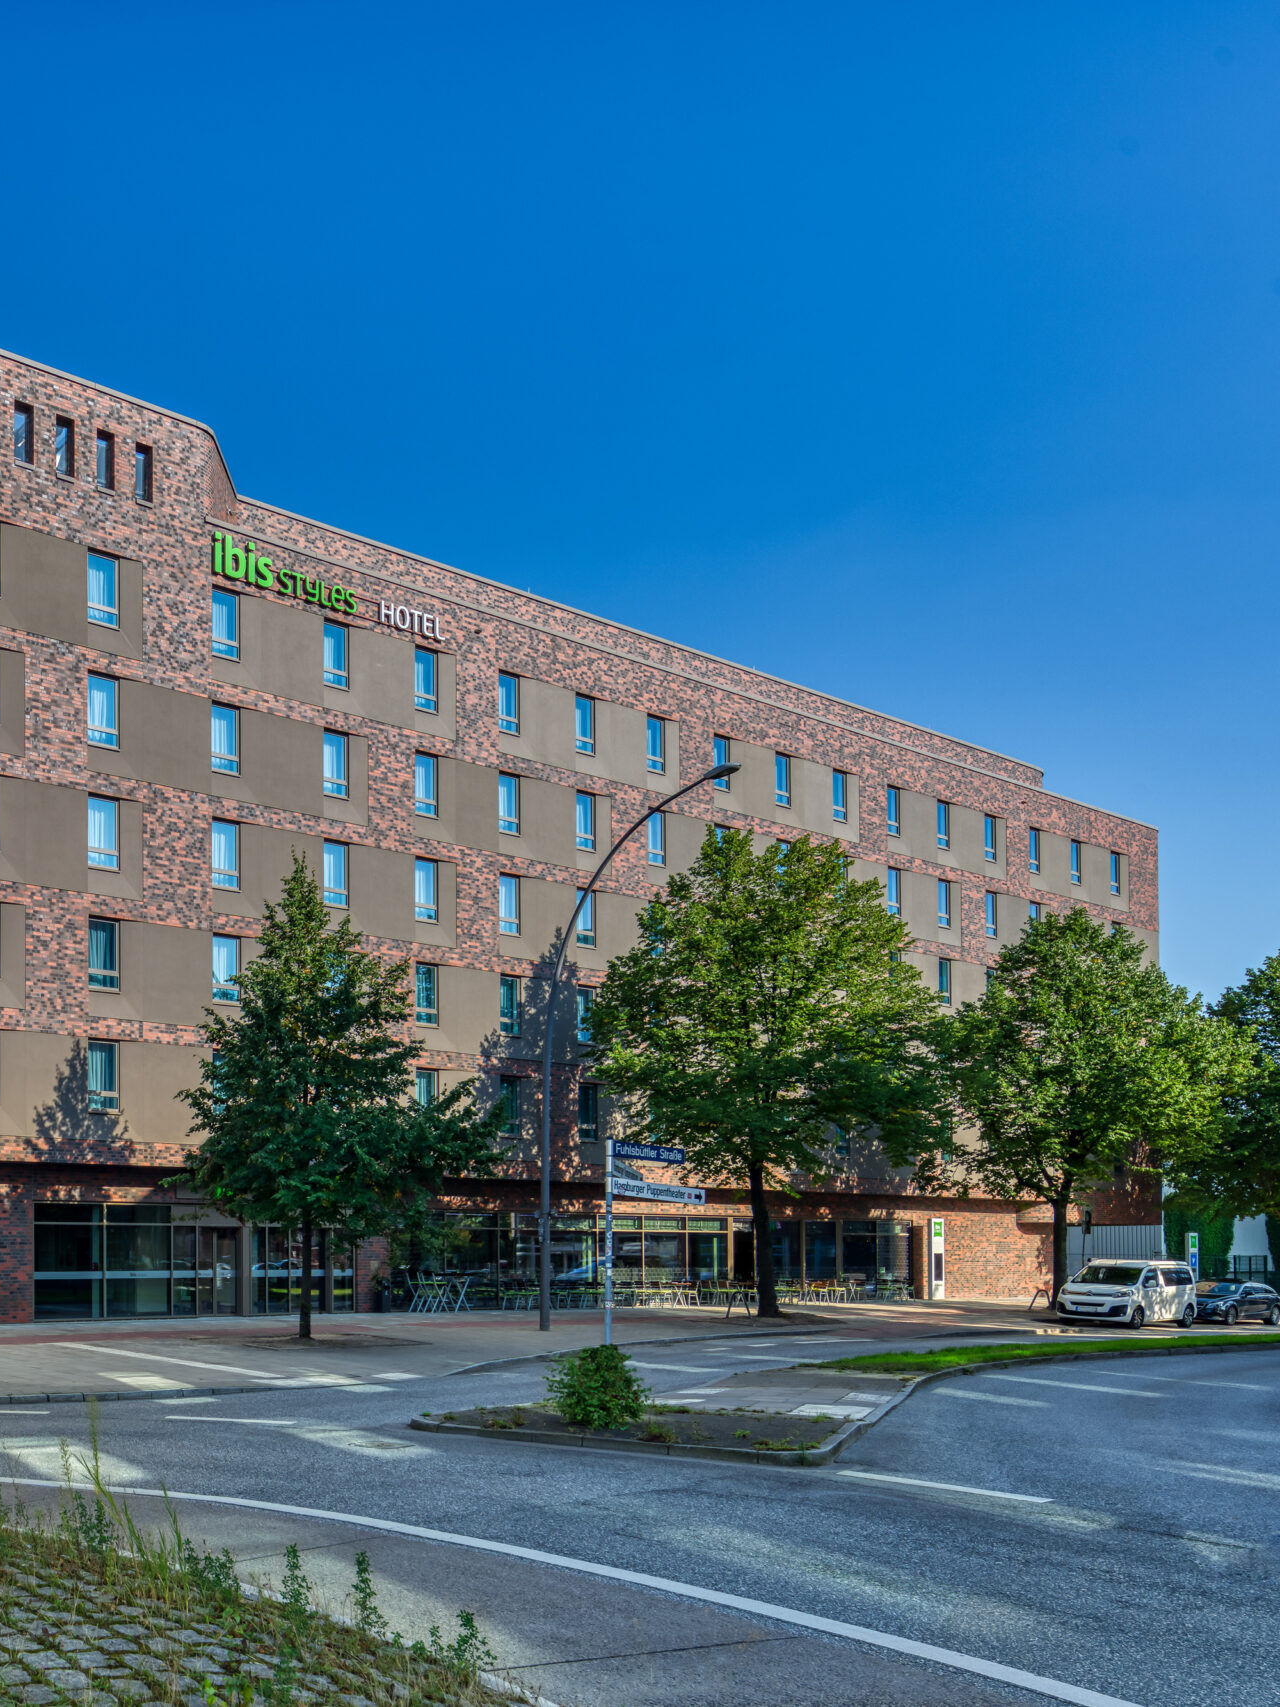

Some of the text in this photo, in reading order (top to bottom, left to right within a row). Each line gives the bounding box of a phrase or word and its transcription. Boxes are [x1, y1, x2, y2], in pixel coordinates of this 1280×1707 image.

[213, 530, 274, 588] ibis
[379, 600, 446, 641] HOTEL
[615, 1143, 683, 1161] Fuhlsbüttler Straße
[614, 1179, 686, 1199] Hamburger Puppentheater
